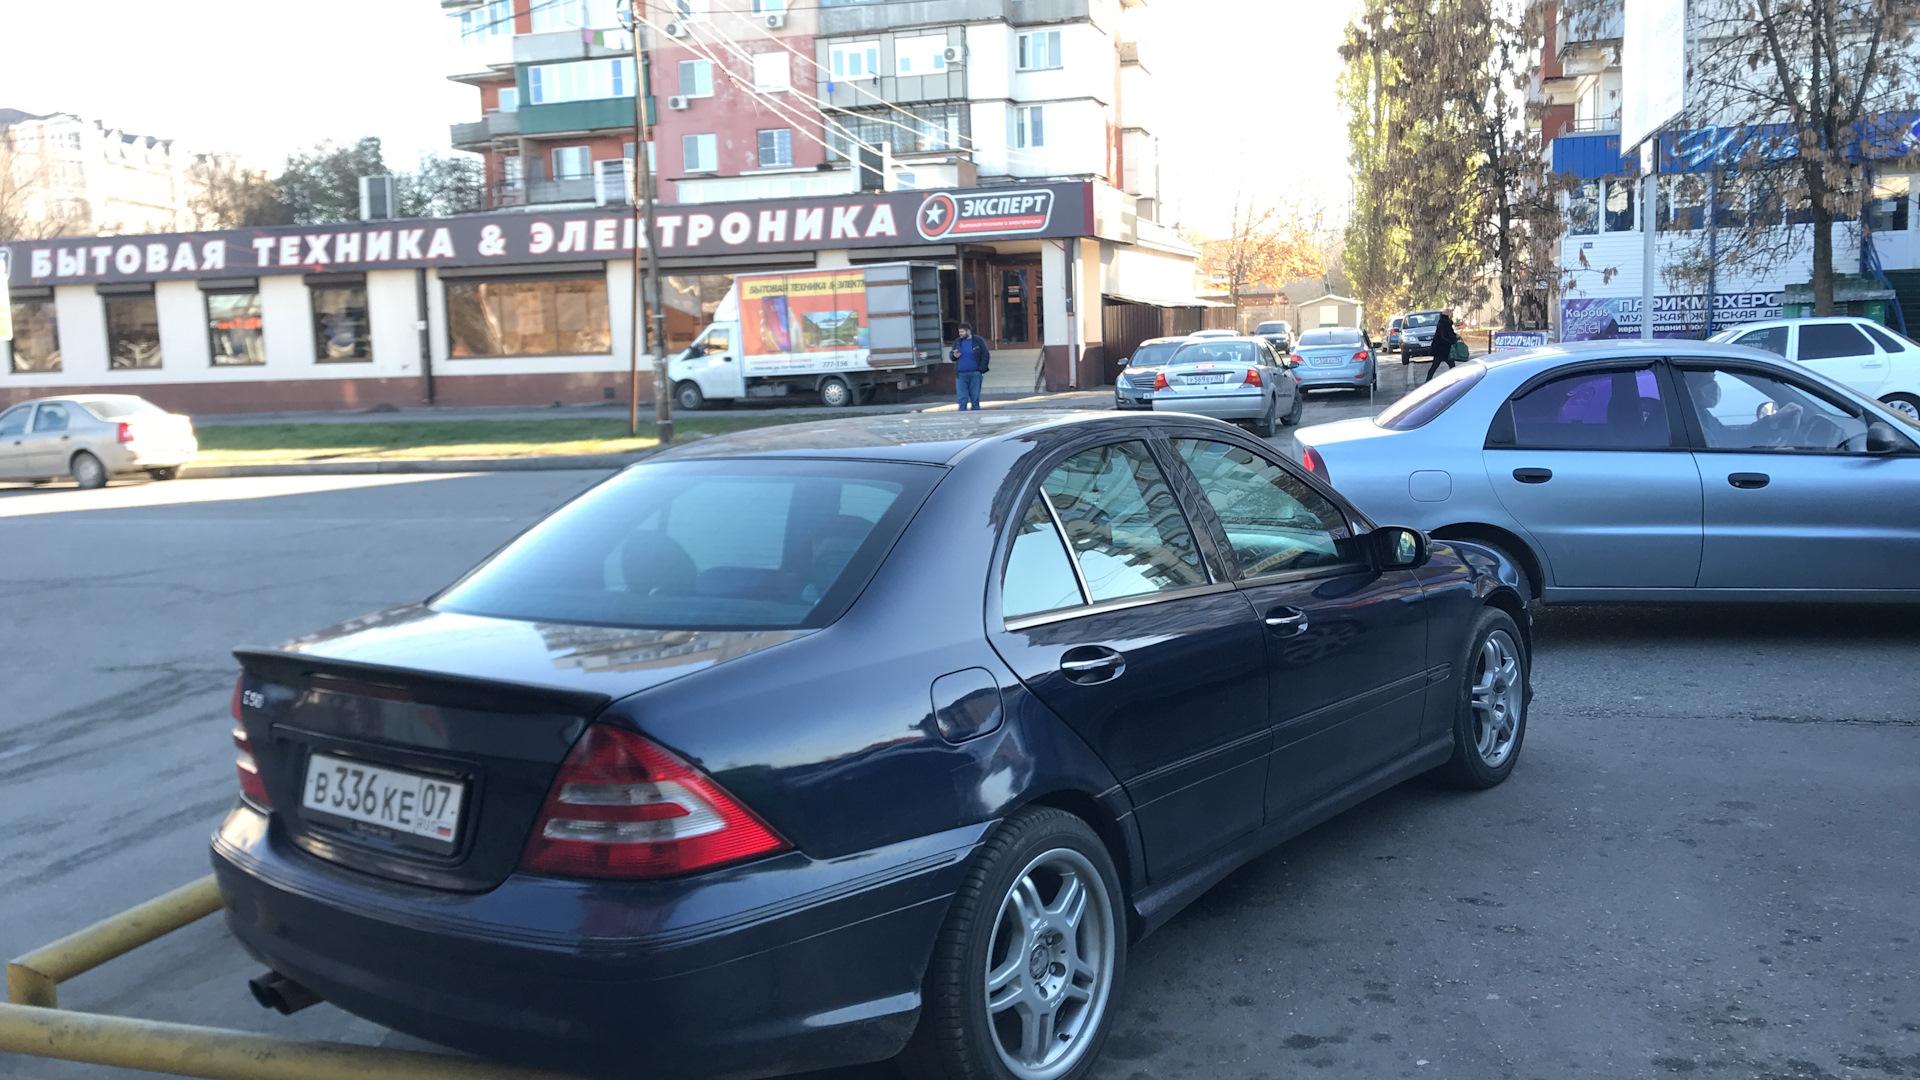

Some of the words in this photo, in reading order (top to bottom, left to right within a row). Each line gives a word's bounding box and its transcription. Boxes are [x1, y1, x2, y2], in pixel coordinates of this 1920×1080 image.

[961, 195, 1046, 217] ЭКСПЕРТ
[31, 239, 226, 278] БЫТОВАЯ
[252, 227, 456, 266] ТЕХНИКА
[478, 225, 506, 256] &
[529, 203, 898, 253] ЭЛЕКТРОНИКА
[791, 282, 827, 292] ТЕХНИКА
[1619, 293, 1783, 312] ПАРИКМАХЕРС
[1565, 309, 1609, 319] Kapous
[1620, 311, 1686, 323] МУСКАЯ
[421, 783, 452, 820] 07
